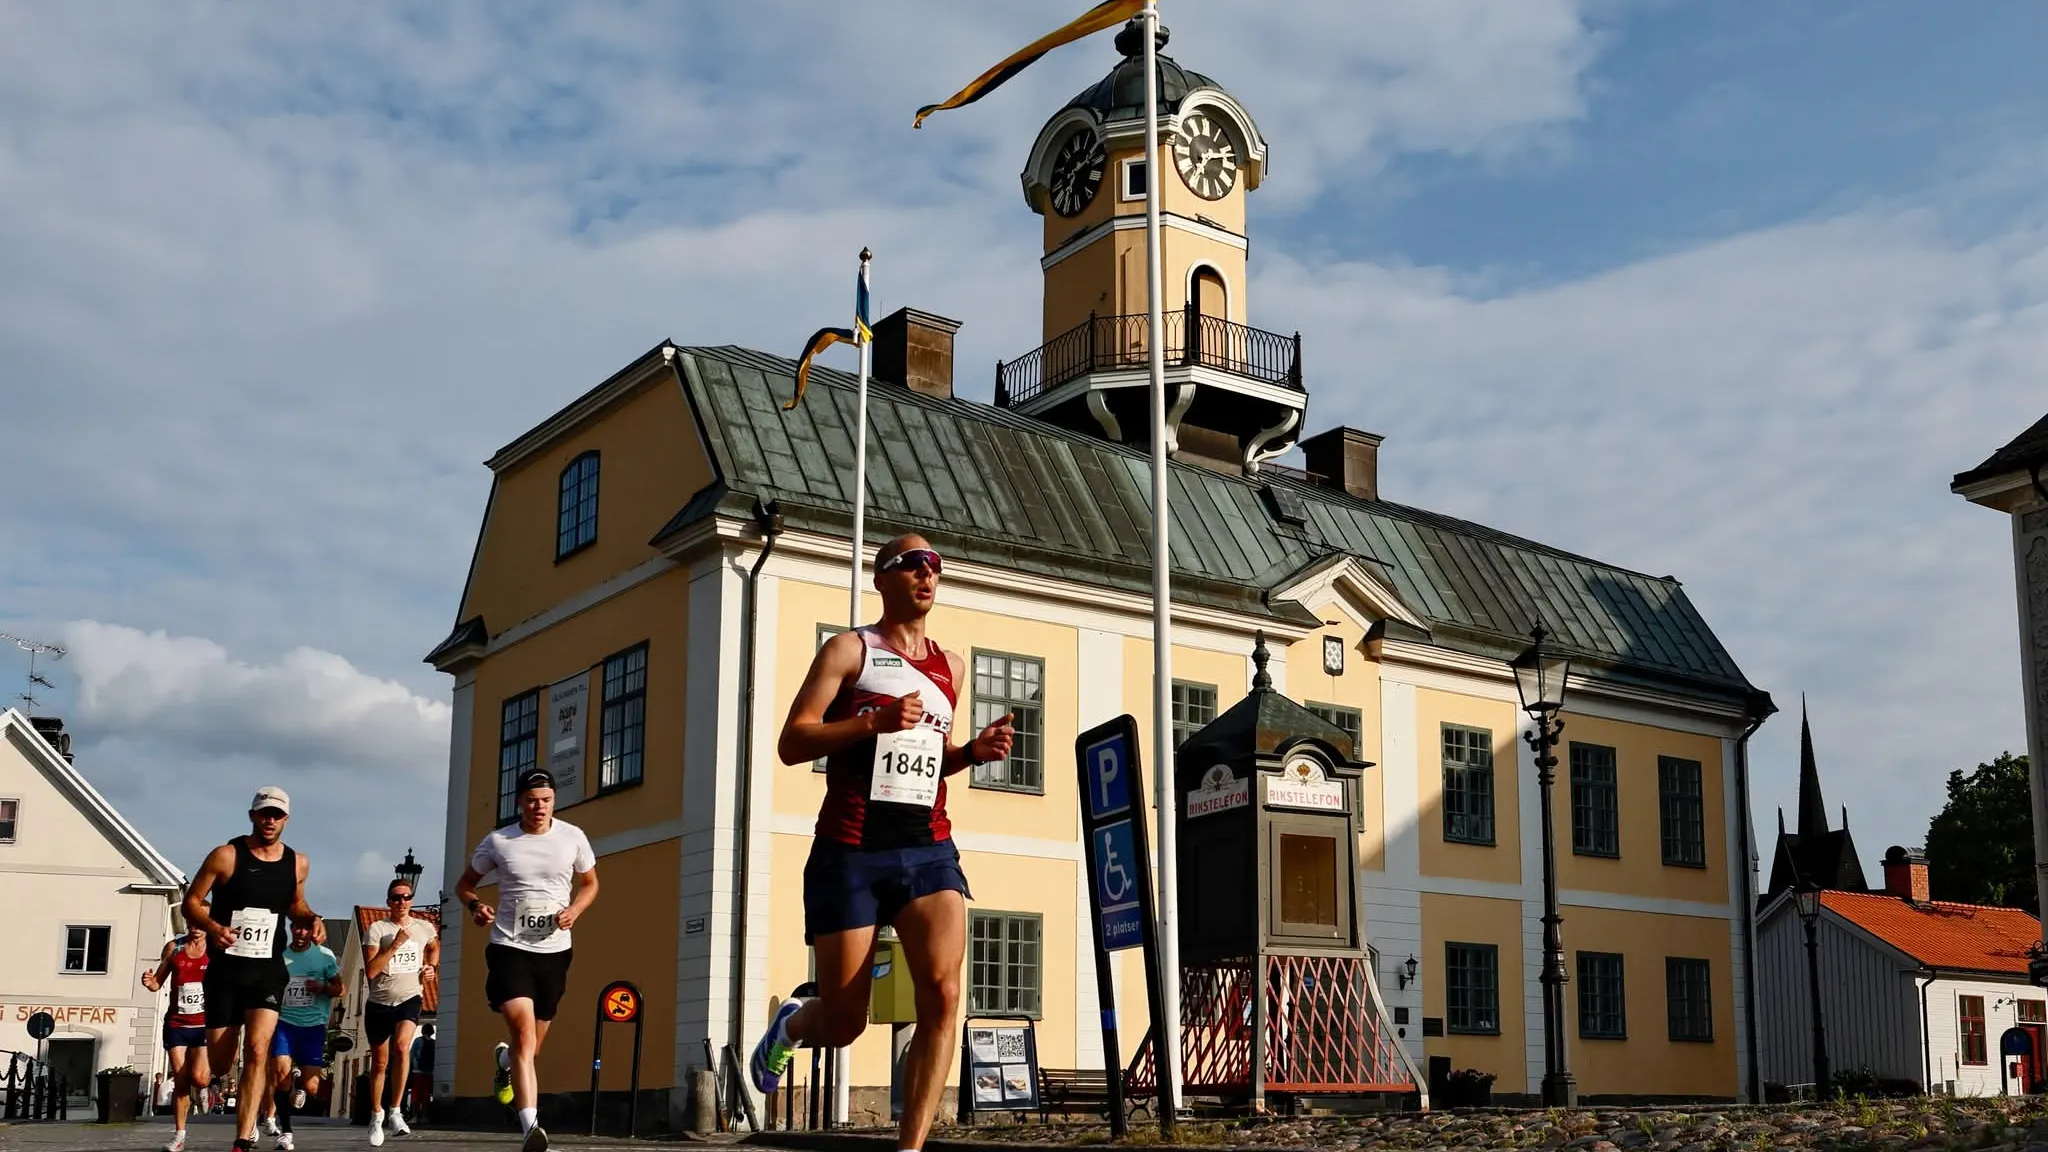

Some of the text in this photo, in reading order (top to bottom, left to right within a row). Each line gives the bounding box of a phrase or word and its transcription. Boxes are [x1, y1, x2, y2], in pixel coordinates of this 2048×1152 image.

[881, 751, 936, 779] 1845
[1098, 747, 1118, 808] P
[1189, 790, 1248, 815] RIKSTELEFON
[1269, 789, 1340, 807] RIKSTELEFON
[519, 914, 553, 929] 1661
[1105, 920, 1140, 940] 2 platser
[235, 925, 269, 942] 1611
[393, 952, 416, 963] 1735
